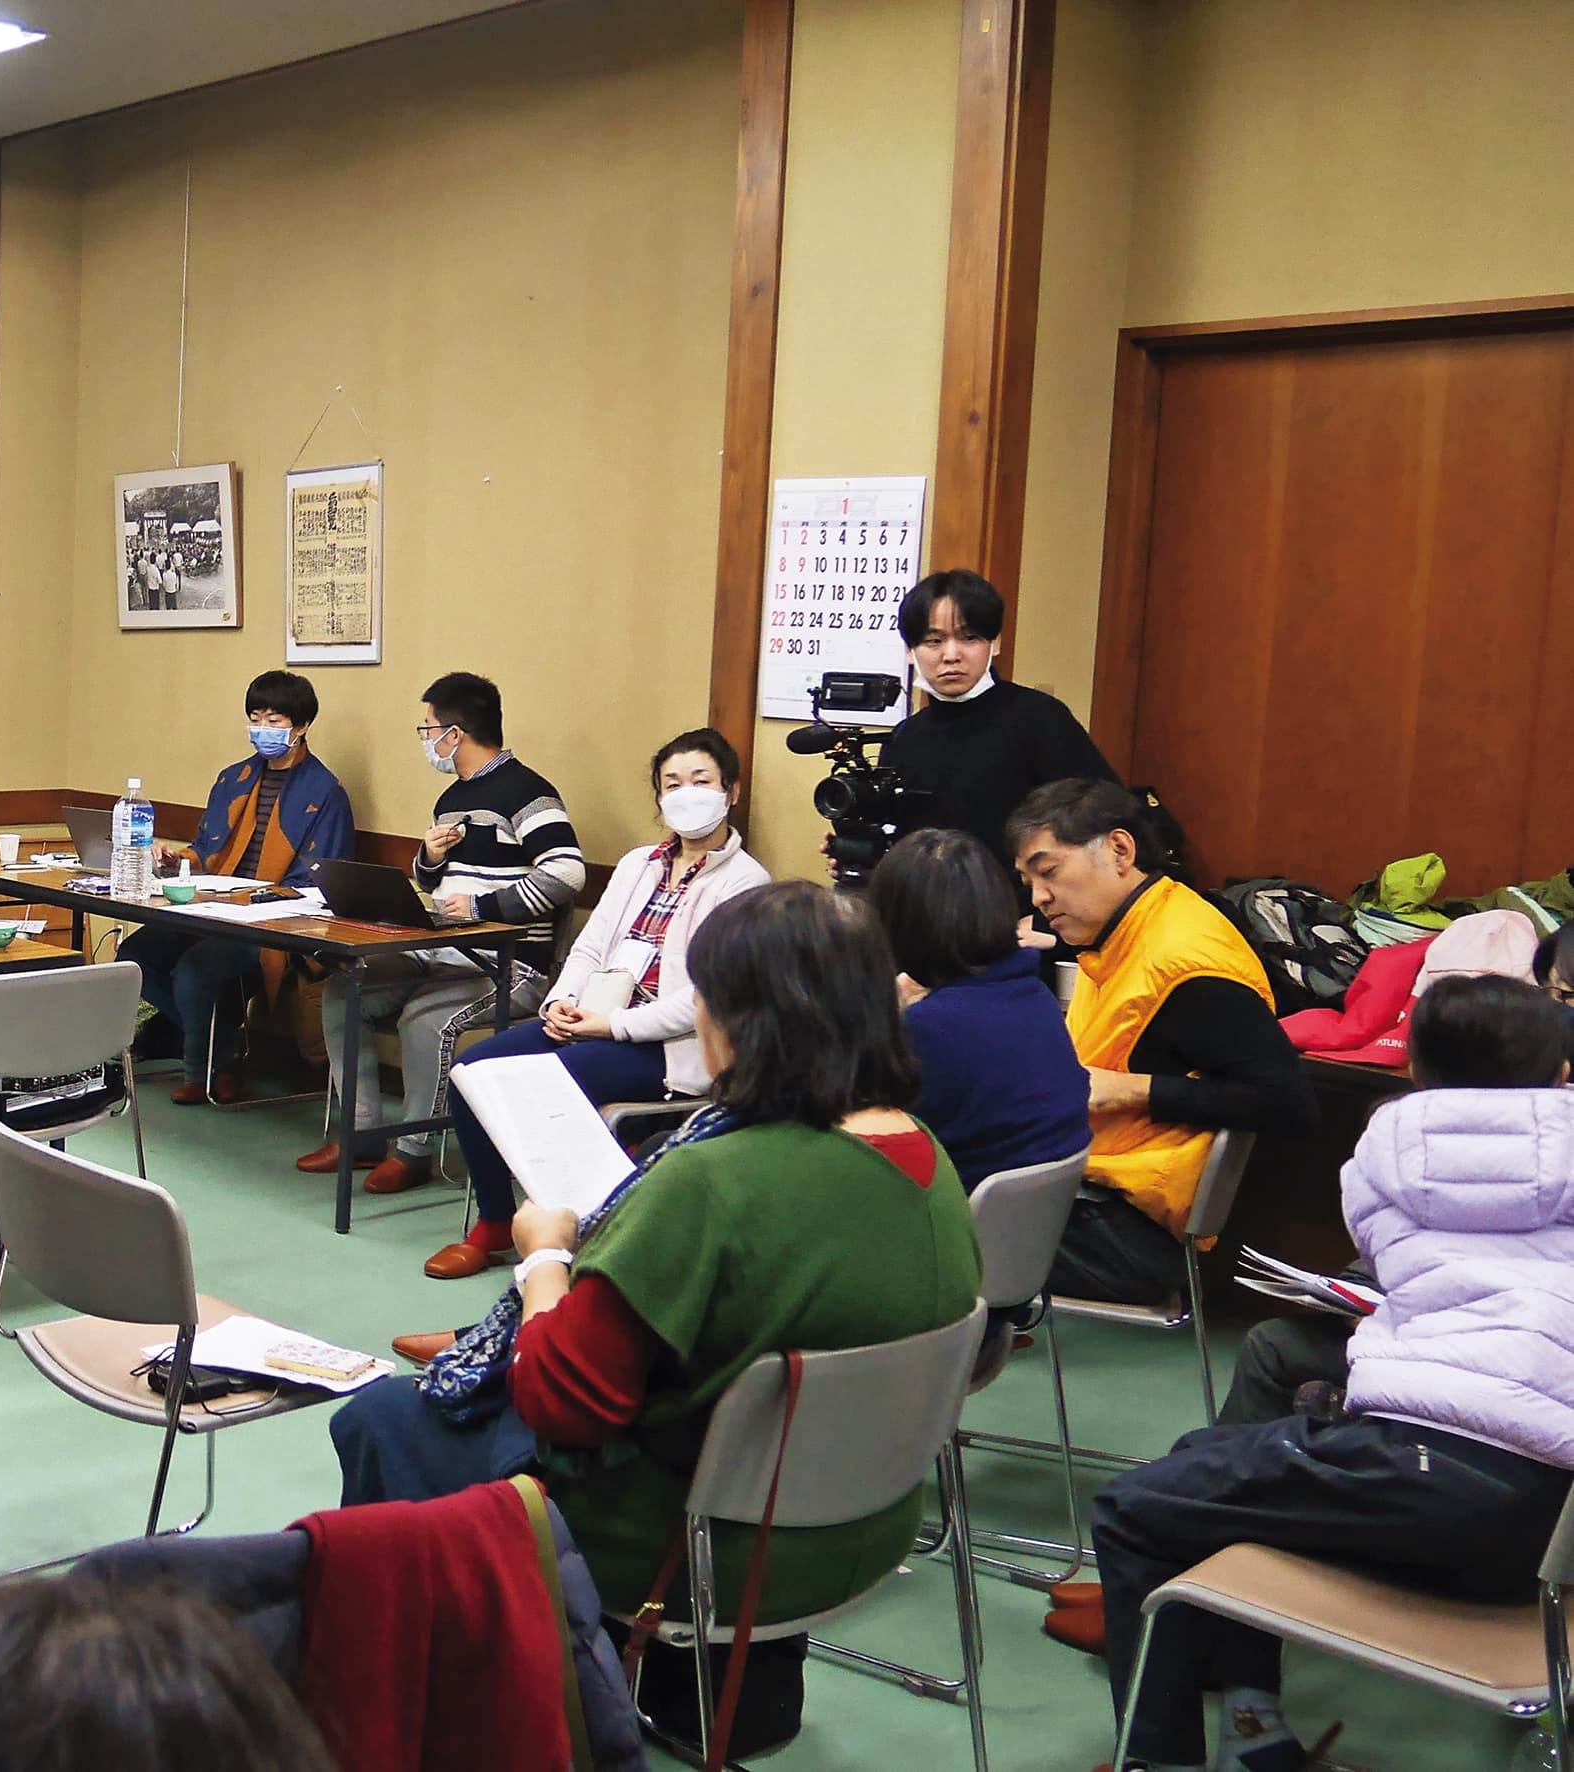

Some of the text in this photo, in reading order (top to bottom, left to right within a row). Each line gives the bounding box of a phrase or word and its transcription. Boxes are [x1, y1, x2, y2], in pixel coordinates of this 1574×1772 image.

[842, 498, 849, 514] 1
[783, 529, 908, 545] 1 2 3 4 5 6 7
[779, 557, 908, 574] 8 9 10 11 12 13 14
[775, 584, 787, 600] 15
[794, 584, 805, 600] 16
[813, 584, 825, 600] 17
[832, 585, 845, 601] 18
[852, 585, 865, 601] 19
[871, 586, 887, 602] 20
[771, 611, 899, 631] 22 23 24 25 26 27 2
[769, 638, 820, 655] 29 30 31
